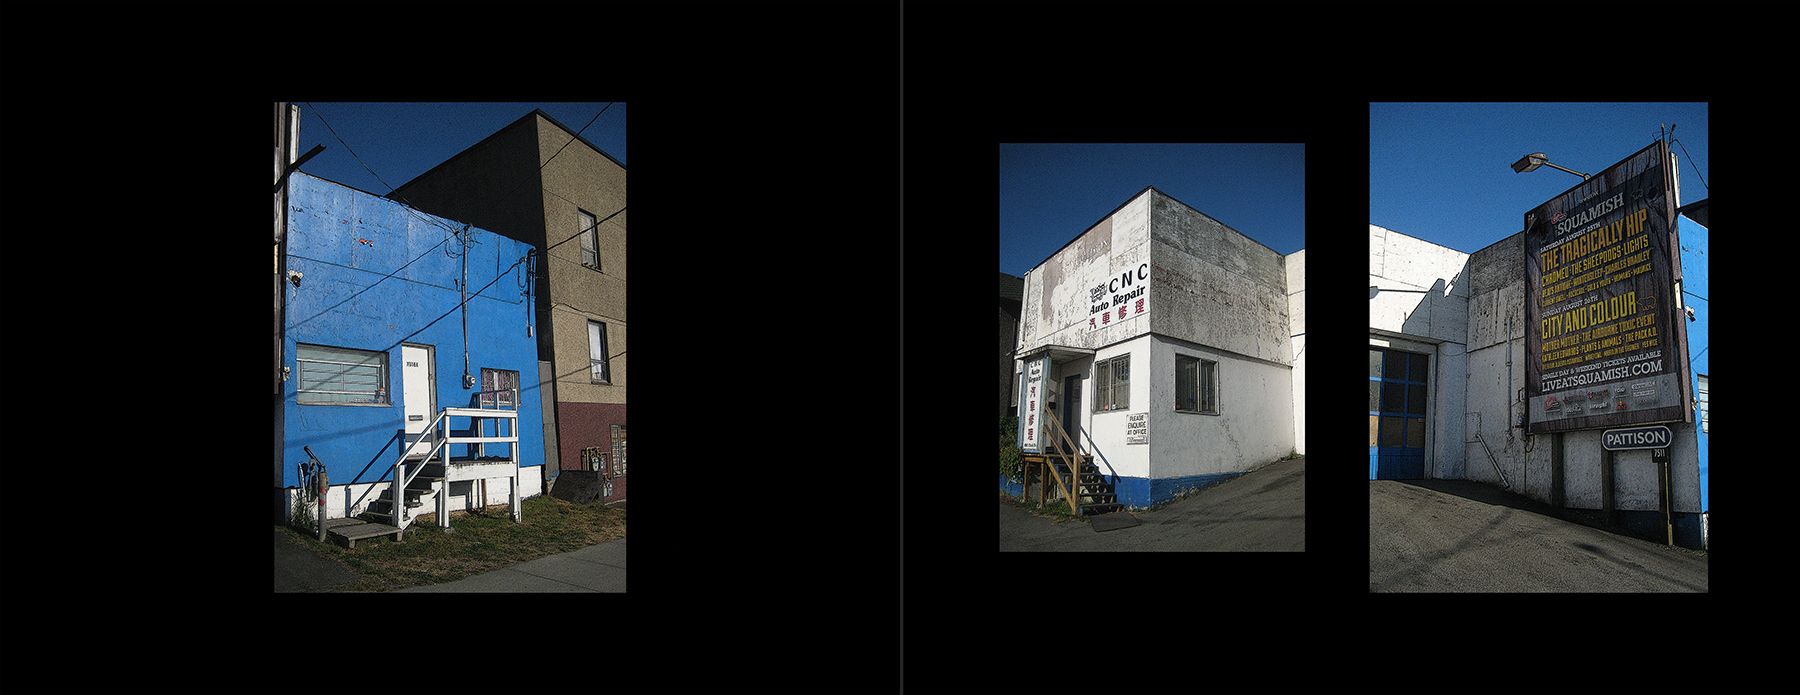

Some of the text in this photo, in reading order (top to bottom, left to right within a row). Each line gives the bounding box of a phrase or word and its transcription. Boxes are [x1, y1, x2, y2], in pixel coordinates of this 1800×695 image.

[1557, 192, 1624, 236] SQUAMISH
[1540, 236, 1565, 252] SATURDAY
[1566, 228, 1586, 242] AUGUST
[1586, 222, 1602, 235] 25TH
[1541, 247, 1560, 272] THE
[1560, 218, 1624, 264] TRAGICALLY
[1626, 208, 1647, 238] HIP
[1542, 234, 1649, 288] CHROMEO THE SHEEPDOGS LIGHTS
[1089, 285, 1146, 316] Auto Repair
[1089, 298, 1144, 331] 汽車修理
[1542, 306, 1562, 318] SUNDAY
[1562, 299, 1582, 312] AUGUST
[1542, 291, 1636, 340] CITY AND COLOUR
[1625, 332, 1634, 342] THE
[1634, 328, 1648, 341] PACK
[1636, 312, 1656, 328] EVENT
[1542, 371, 1558, 380] SINGLE
[1558, 369, 1570, 378] DAY
[1574, 363, 1602, 374] WEEKEND
[1602, 358, 1626, 369] TICKETS
[1626, 350, 1662, 363] AVAILABLE
[1542, 360, 1663, 392] LIVEATSQUAMISH.COM
[1607, 430, 1666, 446] PATTISON
[1654, 448, 1666, 458] 7511
